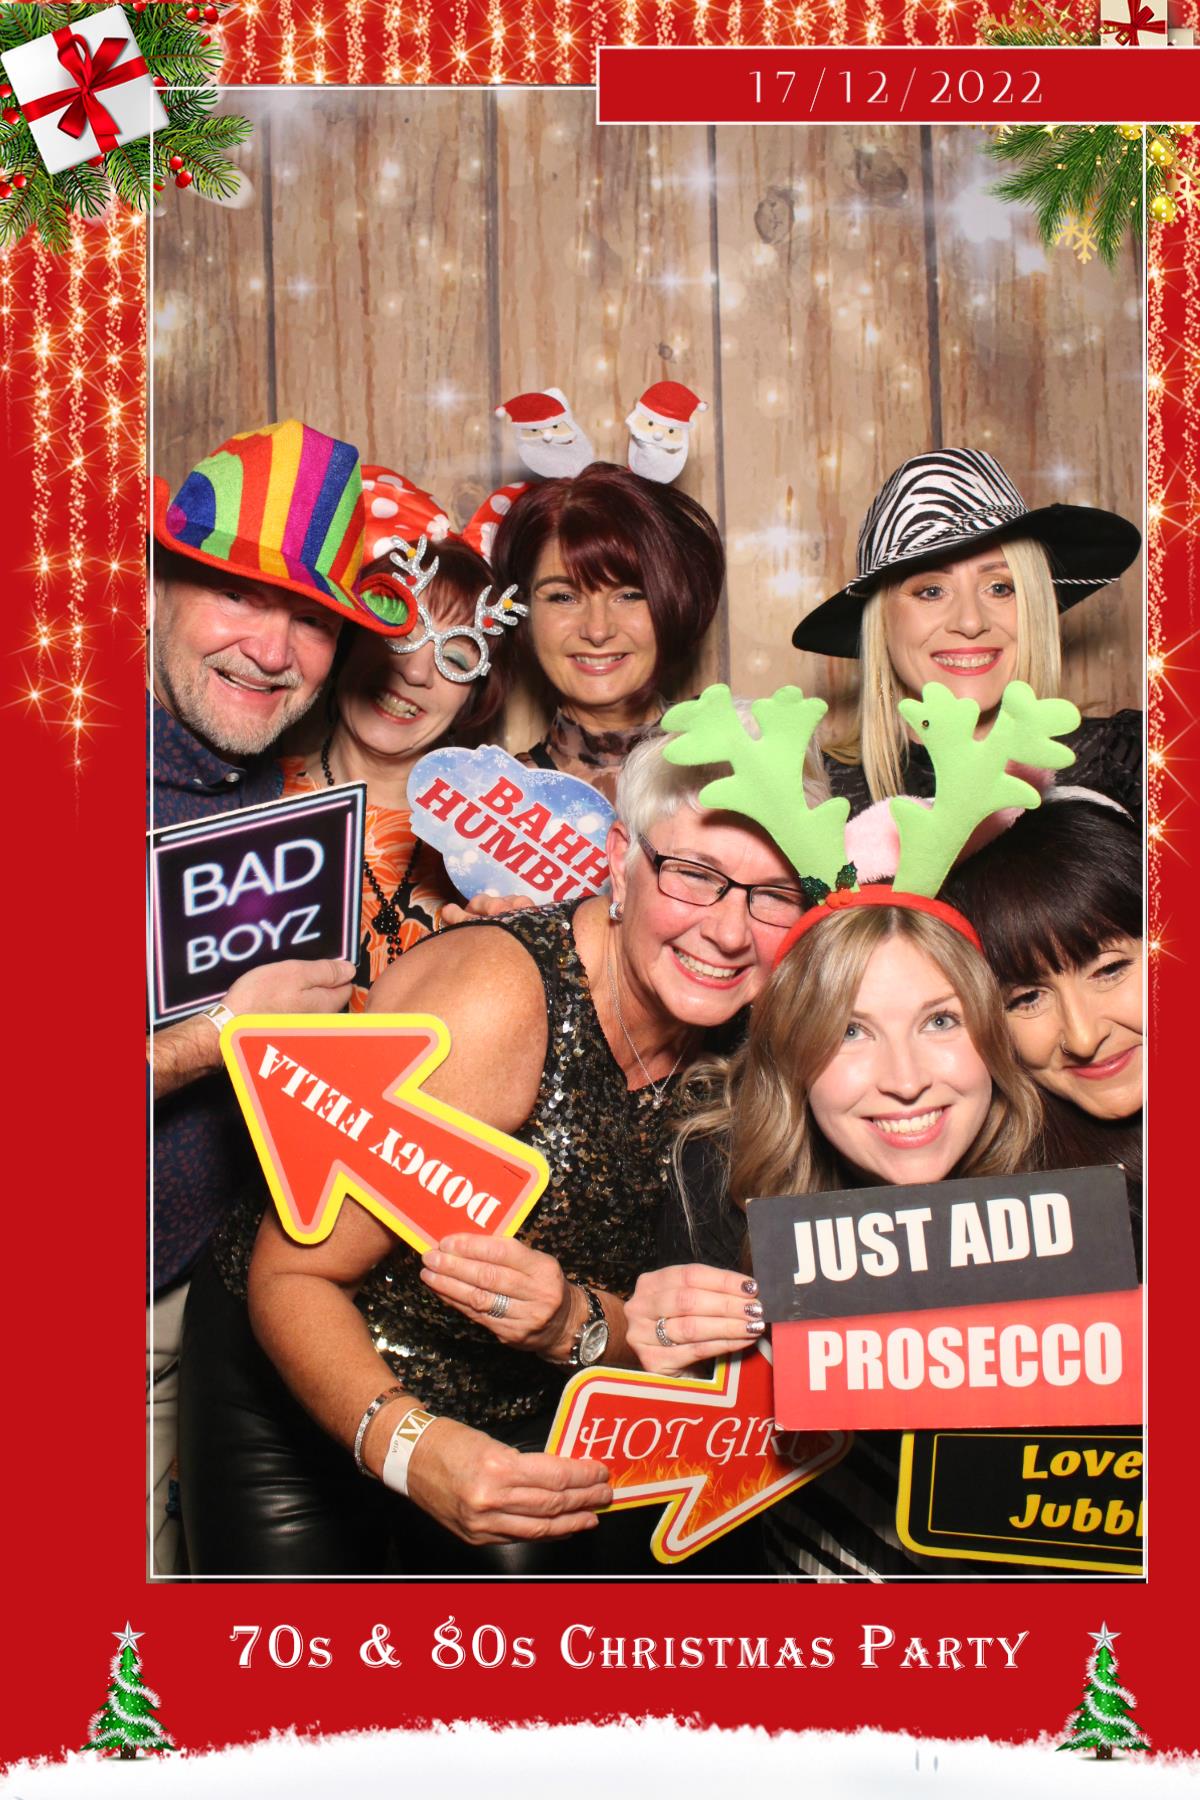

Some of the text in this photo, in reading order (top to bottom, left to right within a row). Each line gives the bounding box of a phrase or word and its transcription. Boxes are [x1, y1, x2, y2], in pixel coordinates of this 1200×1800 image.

[478, 775, 609, 888] BAHH
[183, 838, 325, 917] BAD
[187, 904, 321, 975] BOYZ
[257, 1043, 502, 1229] DODGY FELLA
[793, 1193, 1074, 1285] JUST ADD
[807, 1321, 1123, 1392] PROSECCO
[578, 1416, 703, 1461] HOT
[1022, 1444, 1143, 1480] Love
